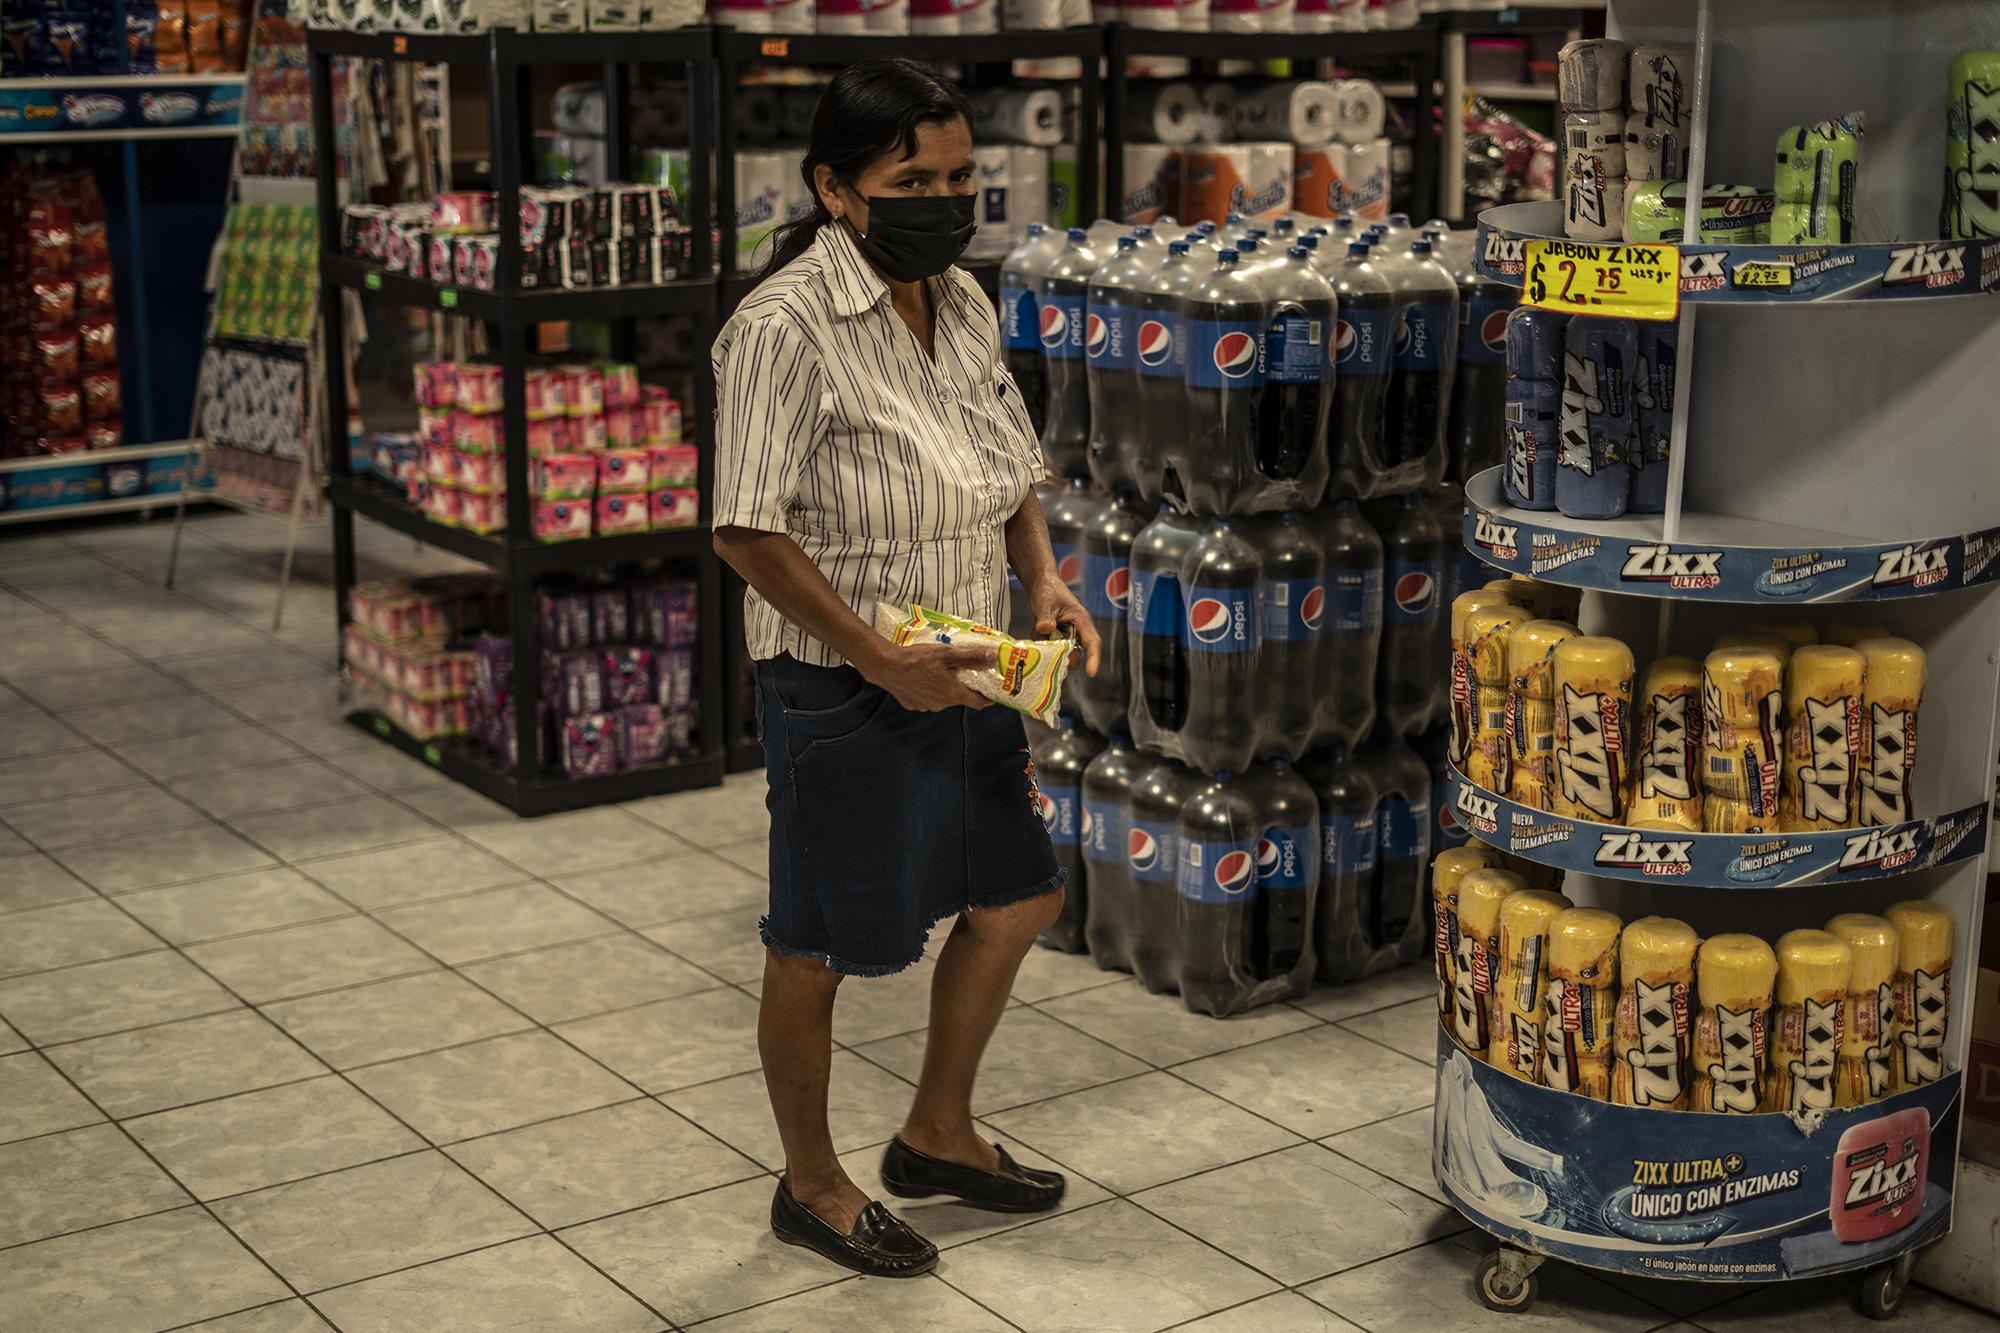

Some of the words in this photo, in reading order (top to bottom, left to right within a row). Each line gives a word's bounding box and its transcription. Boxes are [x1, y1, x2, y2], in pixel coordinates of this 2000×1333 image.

[1544, 241, 1600, 261] JABON
[1607, 247, 1662, 266] ZIXX
[1820, 254, 1856, 272] ENZIMAS
[1883, 244, 1967, 284] Zixx
[1069, 307, 1084, 347] pepsi
[1111, 317, 1123, 357] pepsi
[1360, 322, 1373, 363] pepsi
[1413, 318, 1426, 359] pepsi
[1475, 513, 1519, 548] Zixx
[1532, 533, 1557, 546] NUEVA
[1532, 547, 1596, 576] QUITAMANCHAS
[1621, 545, 1725, 578] Zixx
[1771, 556, 1788, 570] ZIXX
[1795, 566, 1811, 581] CON
[1812, 558, 1848, 576] ENZIMAS
[1872, 545, 1951, 585] Zixx
[1233, 601, 1244, 641] pepsi
[1557, 683, 1616, 819] Zixx
[1641, 694, 1692, 800] Zixx
[1799, 697, 1850, 824] Zixx
[1860, 702, 1907, 827] Zixx
[1457, 783, 1499, 823] Zixx
[1512, 812, 1534, 826] NUEVA
[1283, 839, 1296, 878] pepsi
[1510, 832, 1569, 851] QUITAMANCHAS
[1595, 833, 1695, 865] Zixx
[1740, 843, 1757, 856] ZIXX
[1763, 854, 1779, 868] CON
[1780, 844, 1813, 863] ENZIMAS
[1839, 829, 1920, 870] Zixx
[1627, 978, 1682, 1106] Zixx
[1900, 969, 1947, 1085] Zixx
[1708, 1004, 1758, 1113] Zixx
[1789, 997, 1838, 1111] Zixx
[1633, 1160, 1667, 1184] ZIXX
[1845, 1159, 1920, 1206] Zixx
[1631, 1186, 1681, 1218] ÚNICO
[1686, 1185, 1721, 1213] CON
[1725, 1169, 1799, 1201] ENZIMAS
[1653, 1259, 1674, 1271] único
[1698, 1264, 1707, 1273] en
[1709, 1262, 1729, 1274] barra
[1730, 1264, 1744, 1273] con
